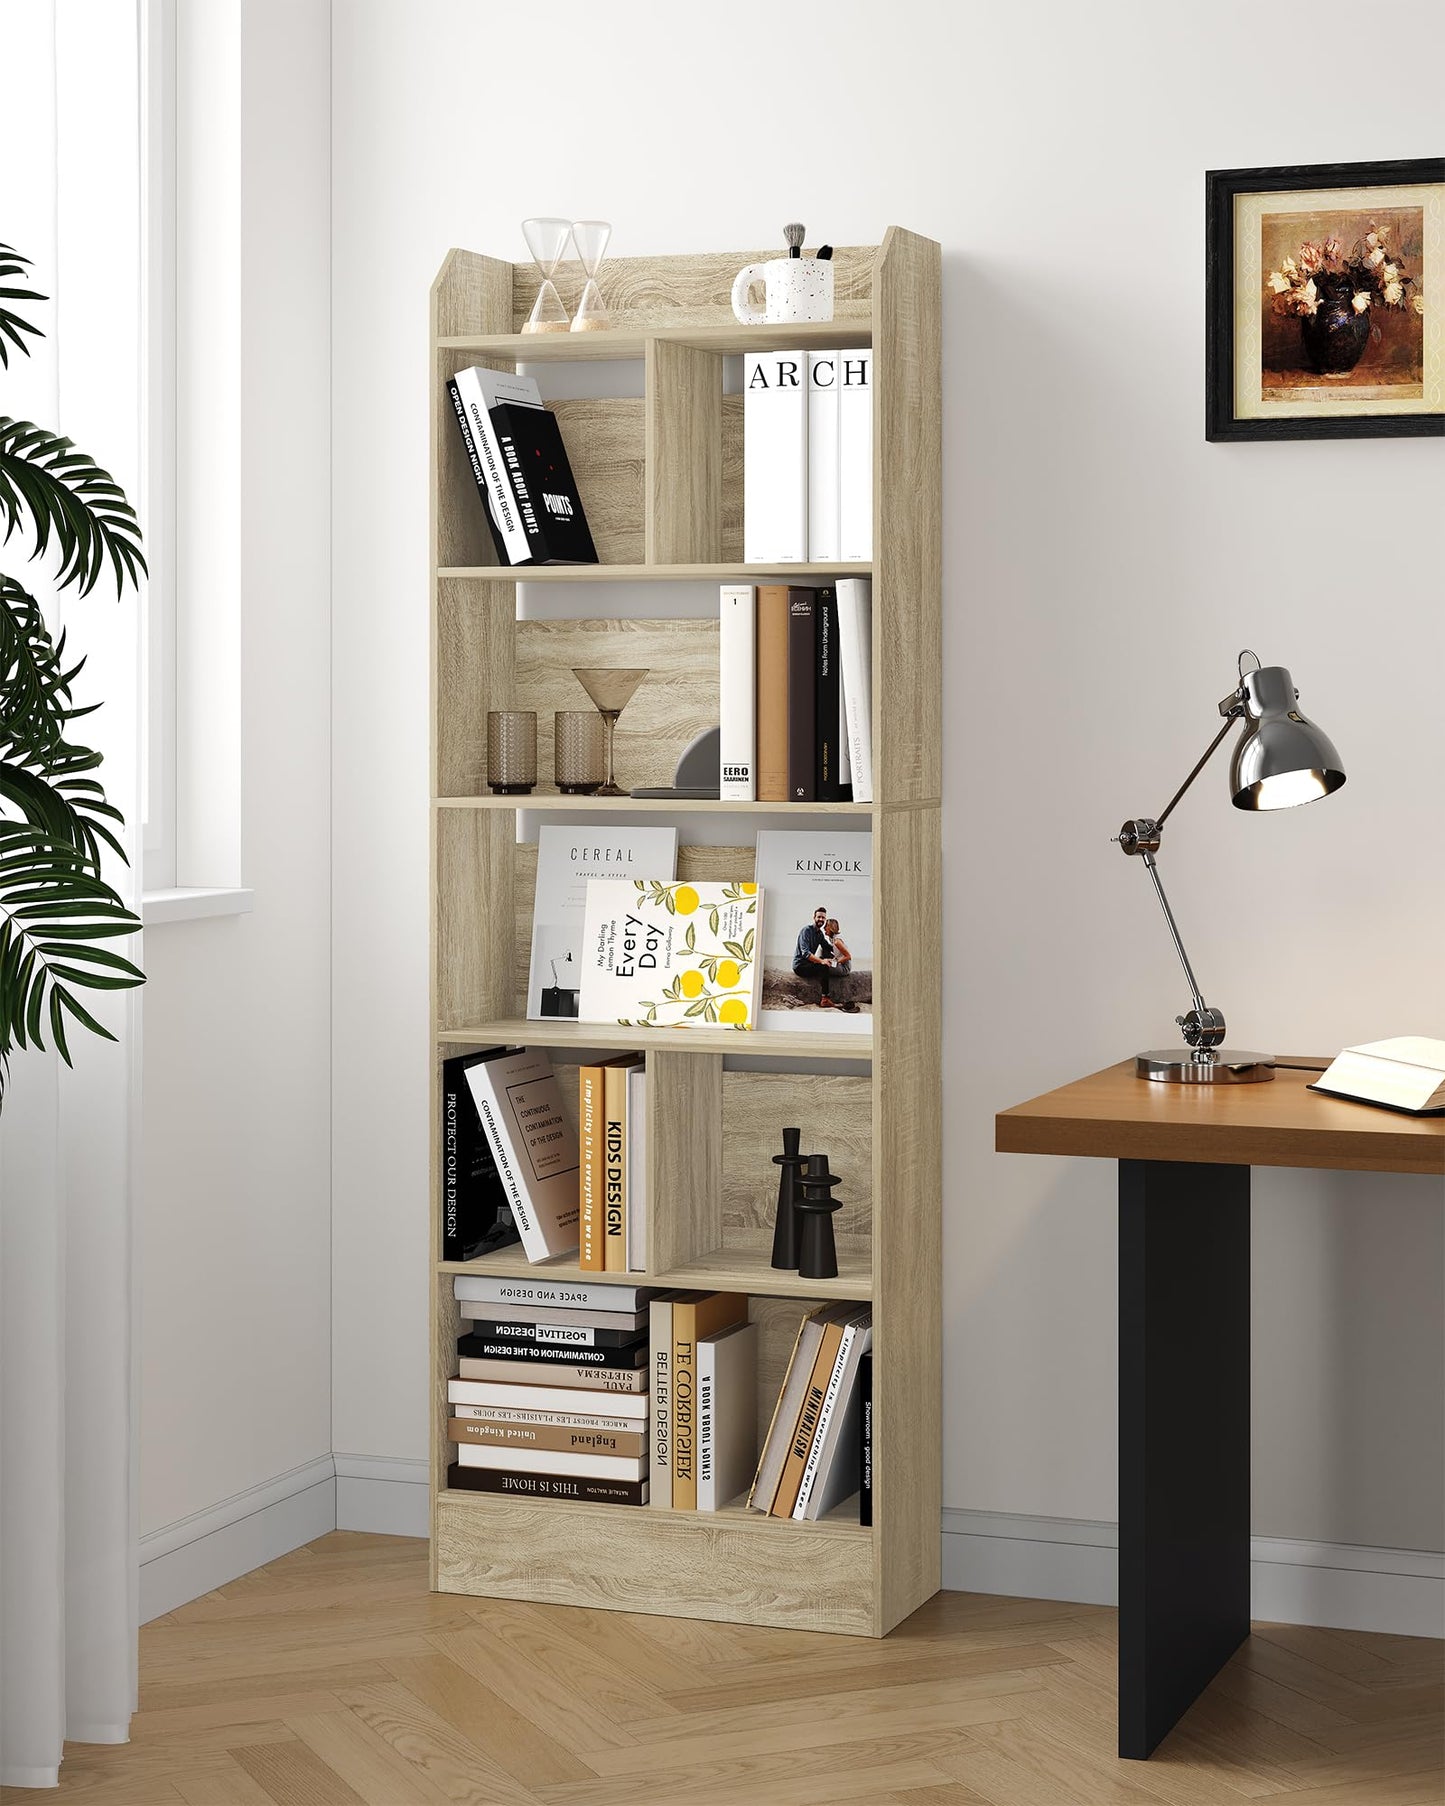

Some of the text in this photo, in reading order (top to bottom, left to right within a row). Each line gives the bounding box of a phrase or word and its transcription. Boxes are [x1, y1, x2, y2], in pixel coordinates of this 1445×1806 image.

[451, 387, 485, 485] OPEN DESIGN NIGHT
[470, 403, 515, 532] CONTAMINATION OF THE DESIGN
[504, 445, 520, 470] BOOK
[512, 472, 529, 499] ABOUT
[521, 502, 540, 534] POINTS
[542, 492, 574, 516] POINTS
[724, 767, 748, 776] EERO
[570, 848, 633, 862] CEREAL
[796, 860, 862, 872] KINFOLK
[597, 924, 608, 967] My Darling
[606, 920, 617, 971] Lemon Thyme
[616, 914, 643, 976] Every
[639, 924, 664, 968] Day
[515, 1096, 525, 1104] THE
[584, 1080, 593, 1133] simplicity
[520, 1104, 551, 1118] CONTINUOUS
[525, 1116, 564, 1133] CONTAMINATION
[586, 1137, 593, 1146] is
[586, 1150, 593, 1160] in
[447, 1093, 456, 1238] PROTECT OUR DESIGN
[481, 1100, 509, 1169] CONTAMINATION
[505, 1169, 513, 1182] OF
[509, 1181, 520, 1199] THE
[515, 1199, 530, 1231] DESIGN
[608, 1121, 622, 1236] KIDS DESIGN
[584, 1164, 593, 1221] everything
[585, 1224, 591, 1239] we
[831, 1338, 849, 1388] simplicity
[577, 1369, 633, 1380] SIETSEMA
[604, 1381, 632, 1391] PAUL
[829, 1391, 835, 1400] is
[473, 1410, 495, 1418] JOURS
[825, 1405, 832, 1414] in
[557, 1416, 571, 1424] LES
[573, 1418, 598, 1426] PROUST
[602, 1420, 628, 1428] MARCEL
[793, 1386, 823, 1460] MINIMALISM
[466, 1426, 536, 1440] United Kingdom
[571, 1435, 616, 1448] England
[808, 1416, 827, 1472] everything
[502, 1477, 579, 1495] THIS IS HOME
[804, 1474, 811, 1488] we
[587, 1487, 606, 1495] WALTON
